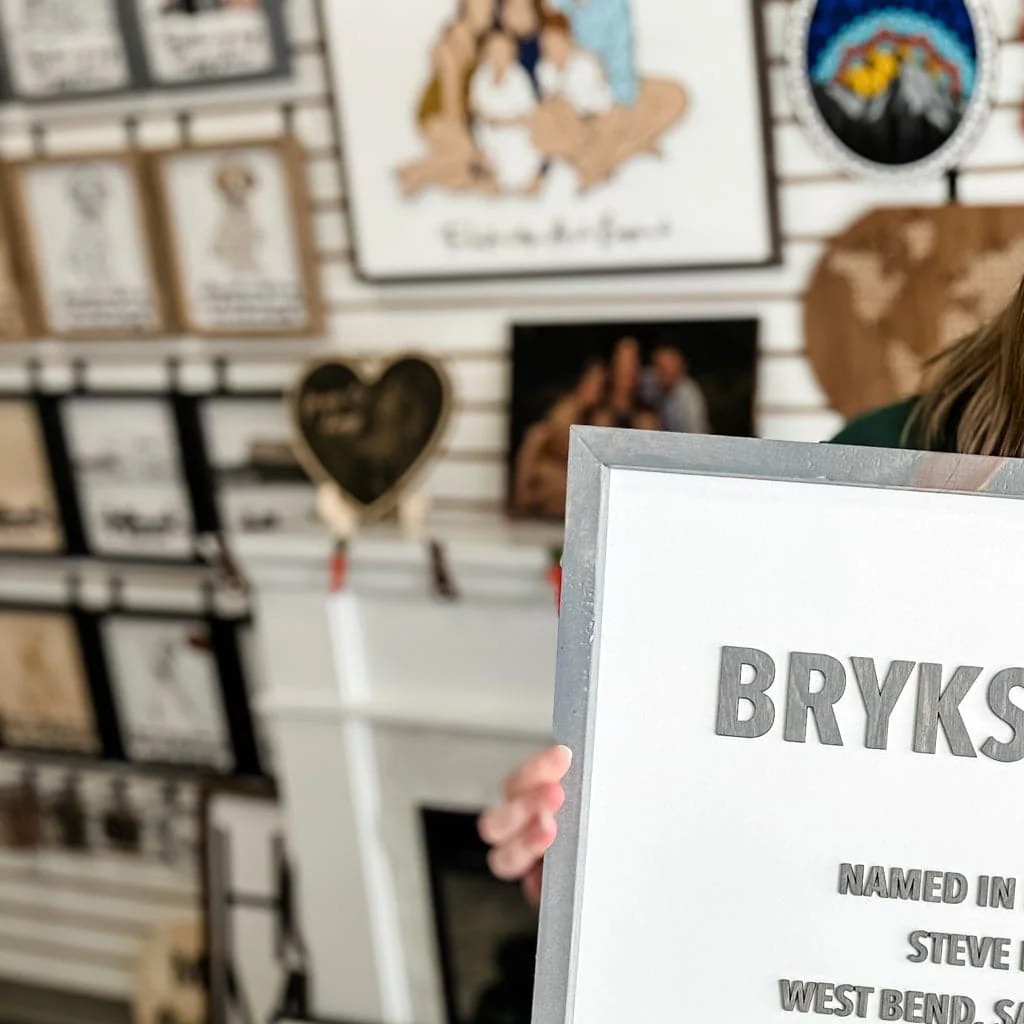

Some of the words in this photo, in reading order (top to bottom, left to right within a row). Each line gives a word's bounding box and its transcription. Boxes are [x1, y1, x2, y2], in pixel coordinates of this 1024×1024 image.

[838, 862, 968, 904] NAMED
[976, 874, 1015, 911] IN
[906, 930, 1011, 971] STEVE
[778, 979, 875, 1020] WEST
